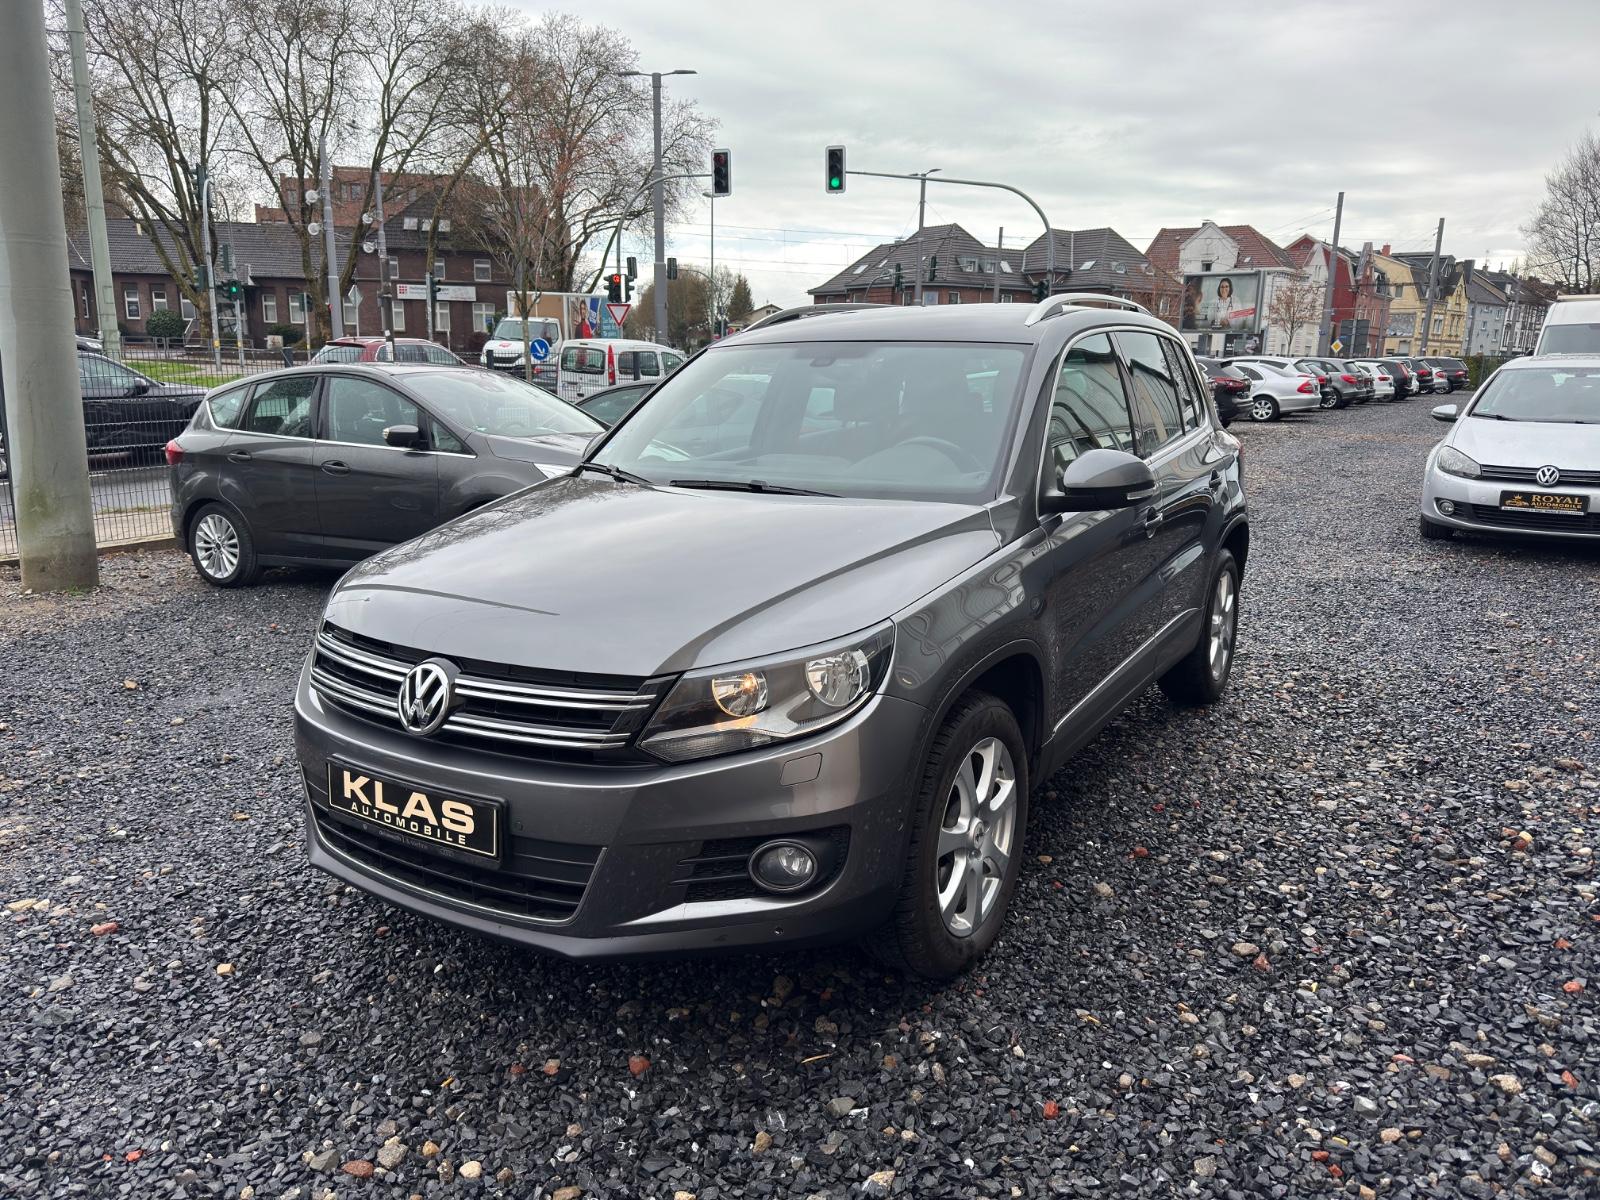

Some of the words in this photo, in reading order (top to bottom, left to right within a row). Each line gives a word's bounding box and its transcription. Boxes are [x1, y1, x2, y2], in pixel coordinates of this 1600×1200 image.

[1536, 466, 1559, 485] VW
[1531, 494, 1583, 505] ROYAL
[399, 663, 449, 731] VW
[343, 770, 475, 835] KLAS
[351, 801, 466, 845] AUTOMOBILE
